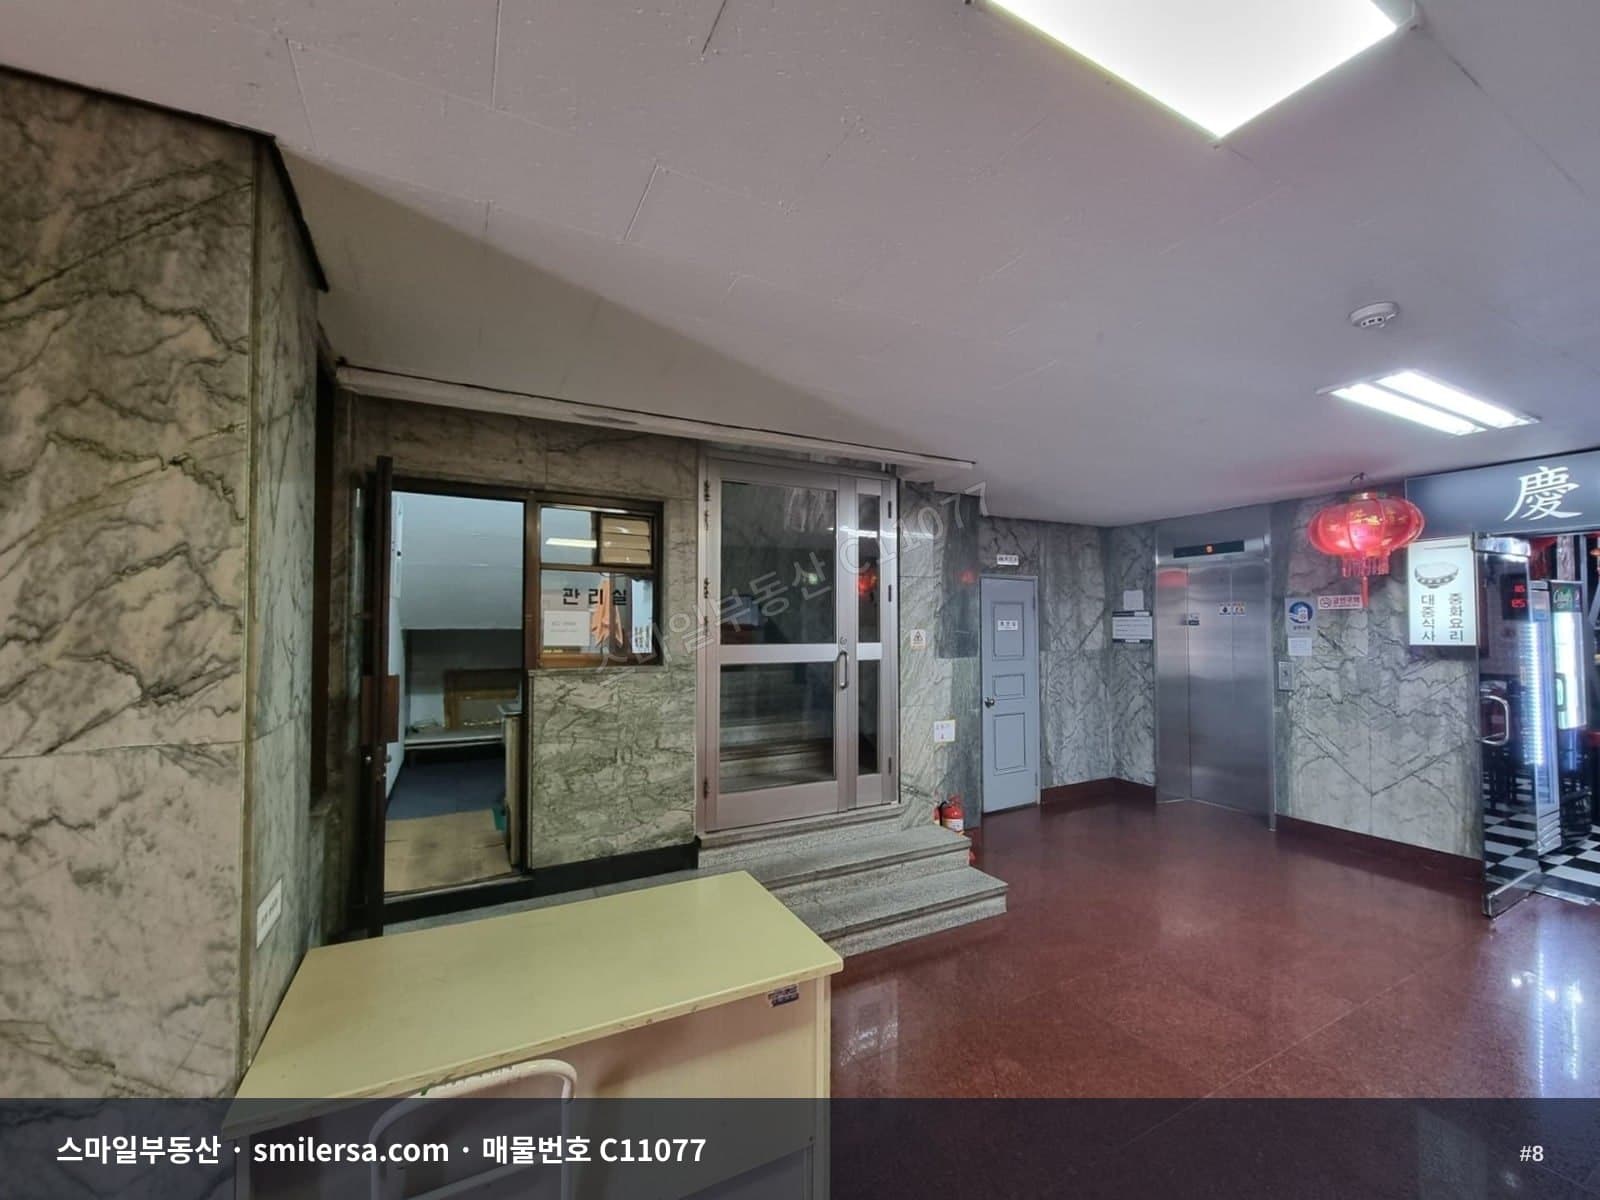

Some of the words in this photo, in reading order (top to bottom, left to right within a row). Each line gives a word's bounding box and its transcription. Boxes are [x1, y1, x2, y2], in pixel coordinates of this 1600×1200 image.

[1504, 466, 1583, 521] 慶
[562, 587, 627, 606] 관리실
[1421, 594, 1435, 642] 대중식사
[1448, 593, 1464, 642] 중화요리
